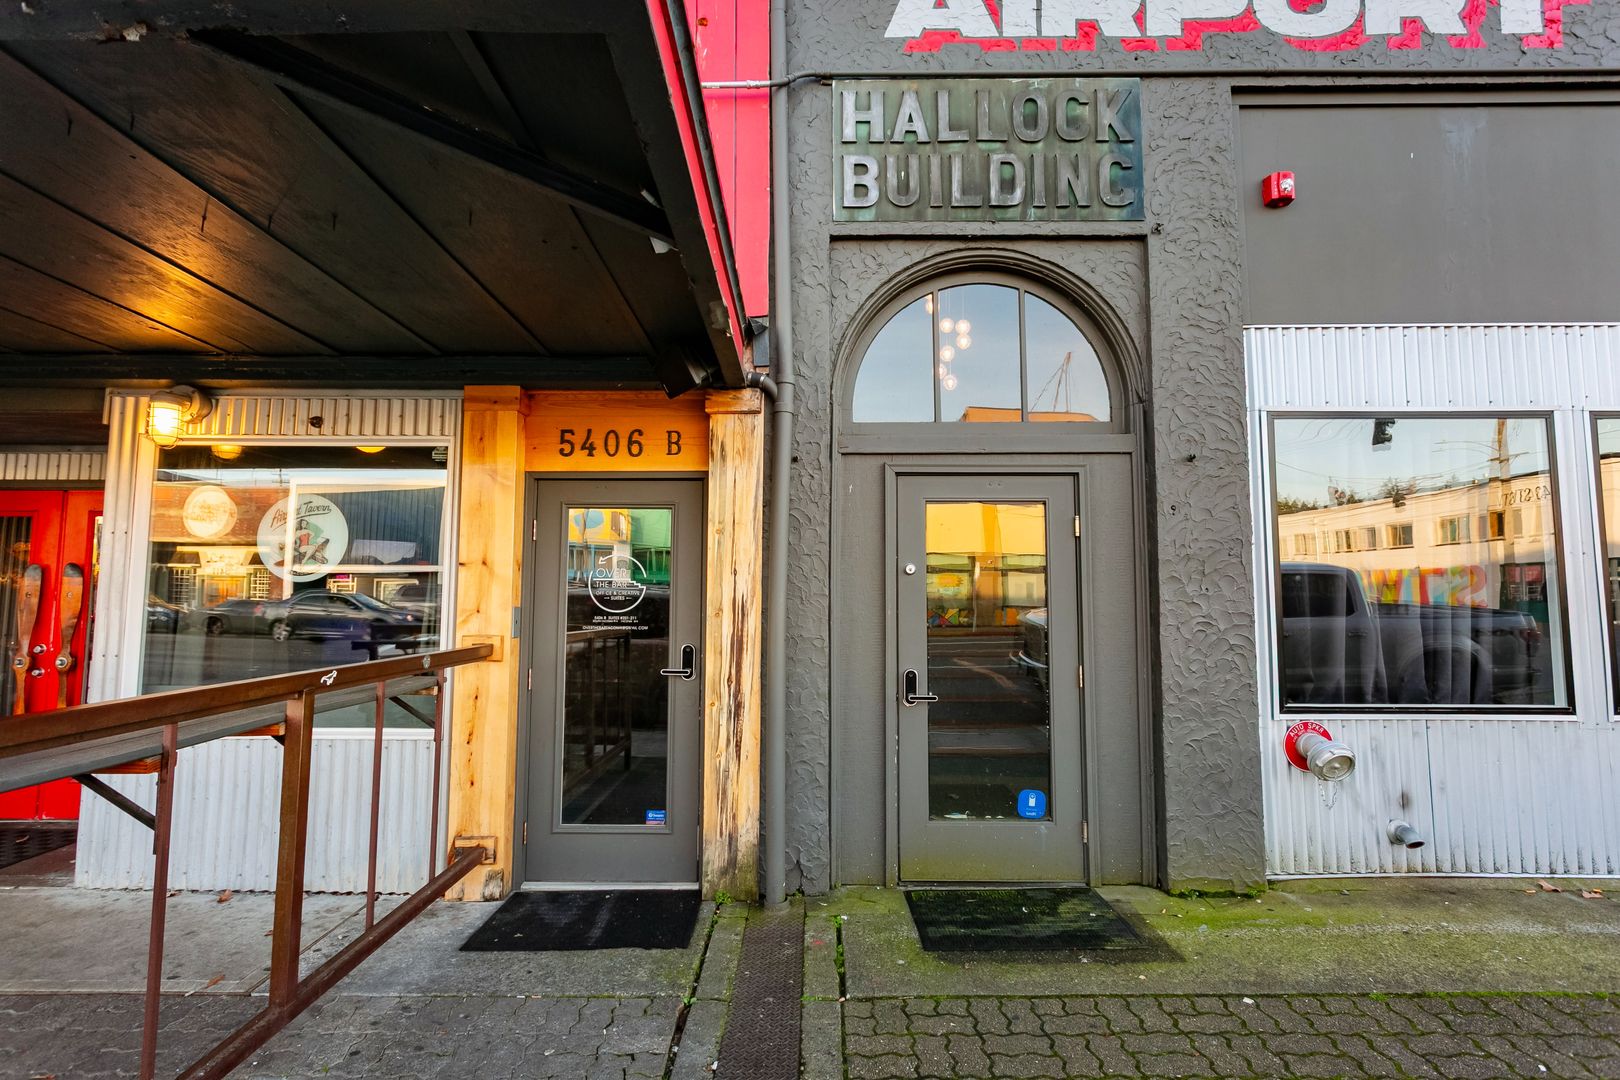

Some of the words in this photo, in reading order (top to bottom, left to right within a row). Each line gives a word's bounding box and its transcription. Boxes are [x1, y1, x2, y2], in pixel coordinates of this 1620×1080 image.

[841, 88, 1134, 143] HALLOCK
[558, 428, 645, 458] 5406
[665, 430, 682, 456] B
[303, 500, 332, 514] Tavern
[596, 567, 627, 578] OVER
[1289, 723, 1304, 738] AUTO
[1307, 722, 1325, 733] SPKR
